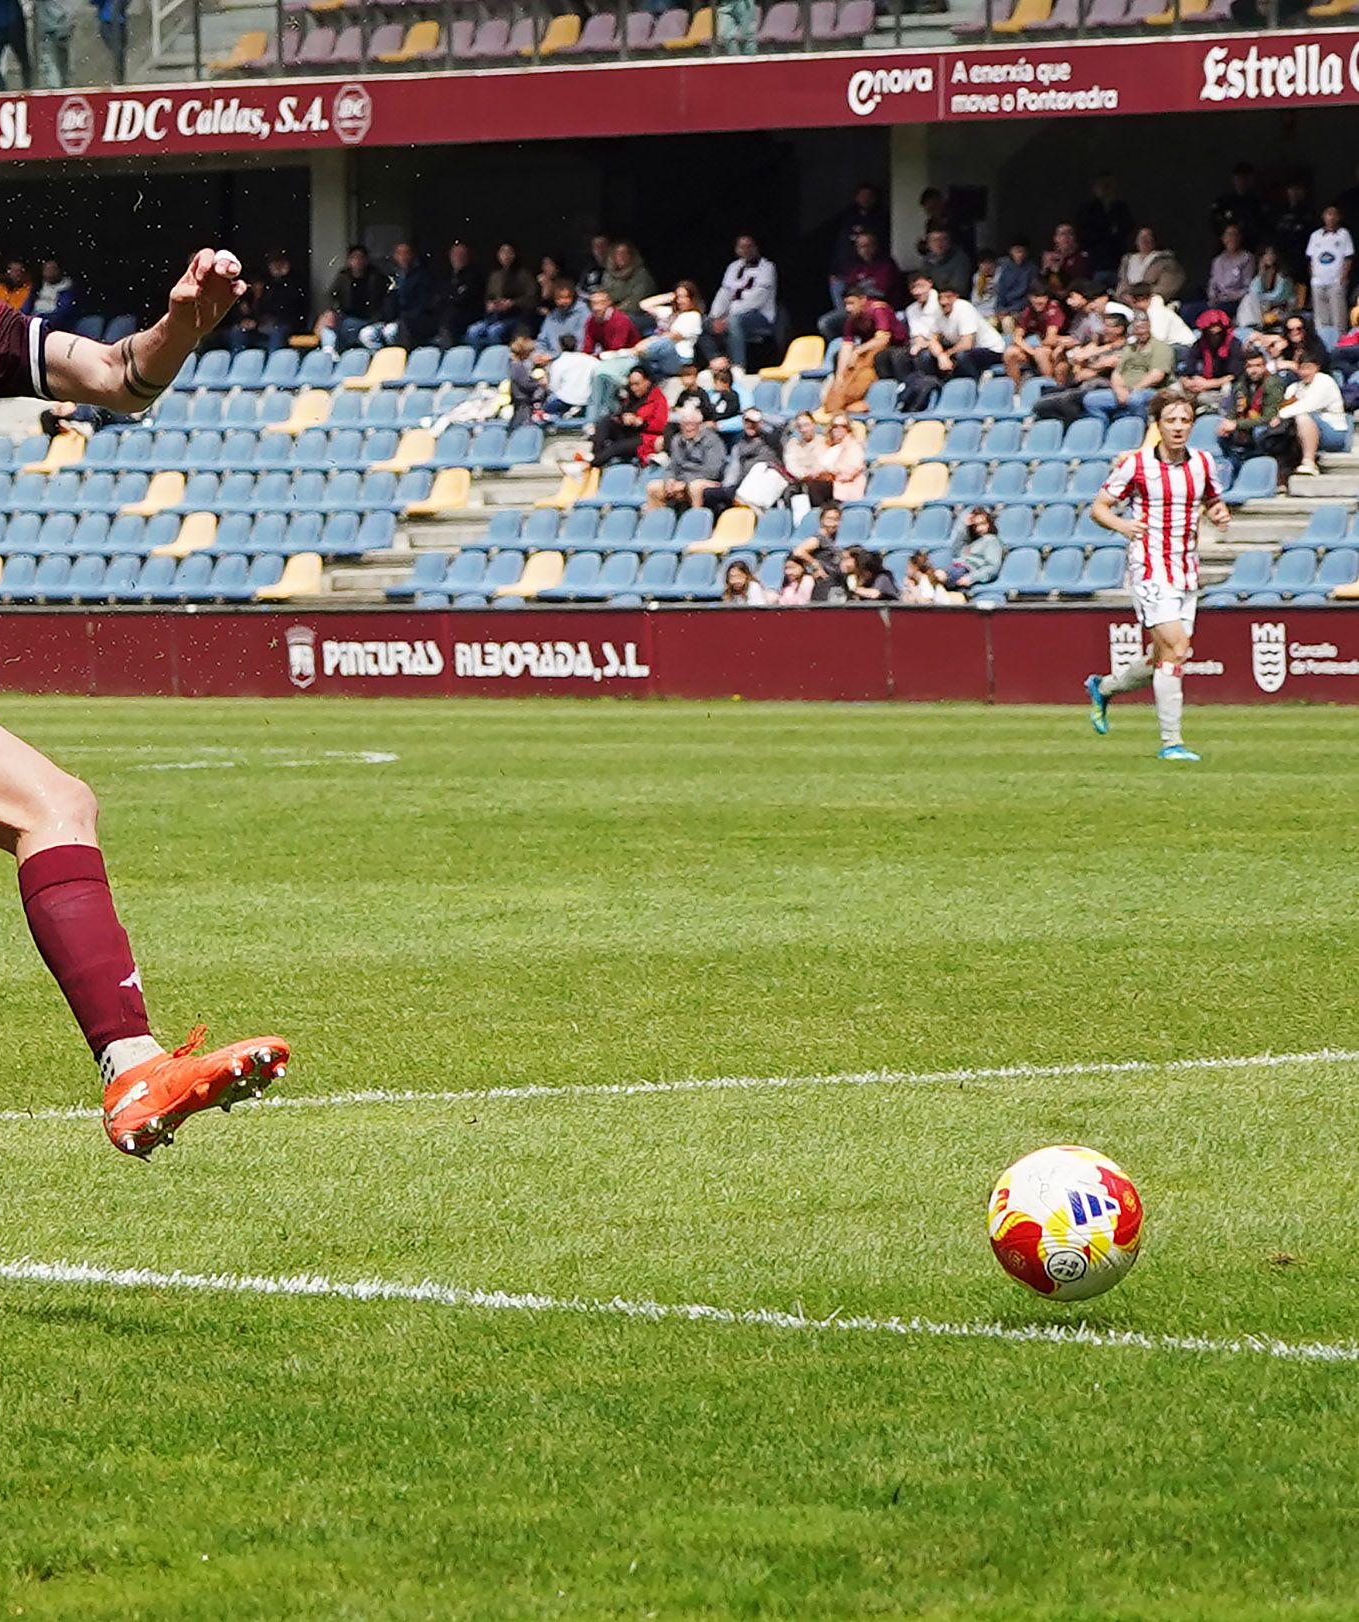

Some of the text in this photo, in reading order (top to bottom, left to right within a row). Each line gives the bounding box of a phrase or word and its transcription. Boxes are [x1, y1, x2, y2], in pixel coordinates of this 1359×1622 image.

[951, 60, 968, 84] A
[1035, 62, 1072, 86] que
[1200, 43, 1344, 101] Estrella
[951, 84, 1119, 112] move o Pontevedra
[0, 101, 32, 149] SL
[102, 96, 330, 142] IDC Caldas, S.A.
[322, 640, 444, 676] PINTURAS
